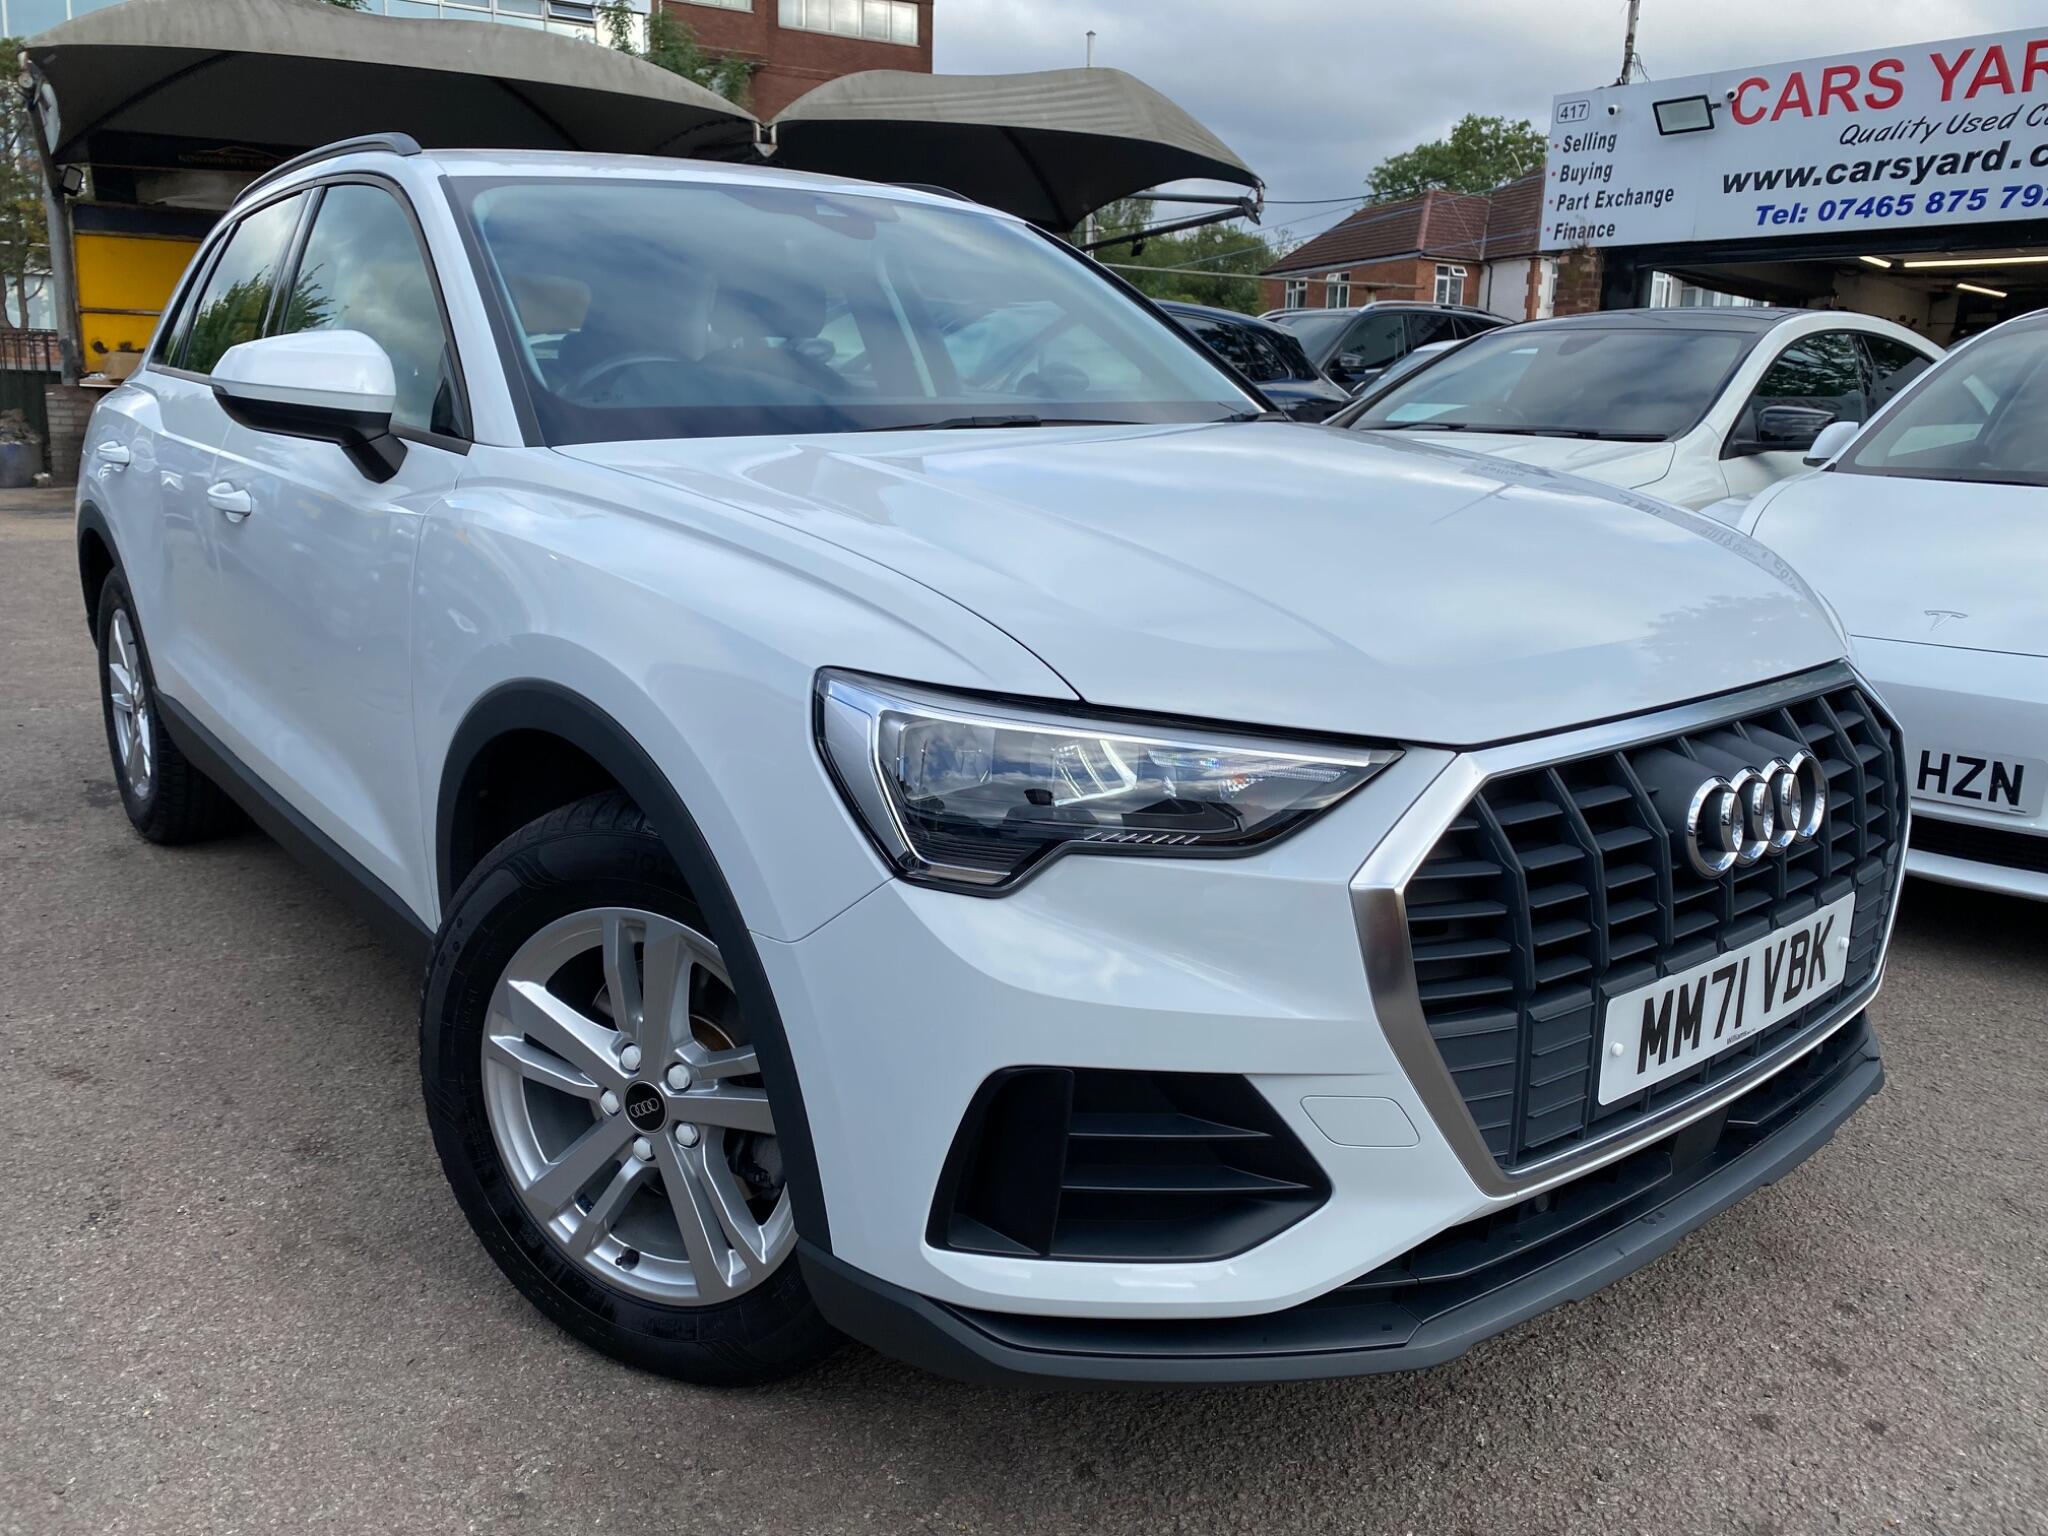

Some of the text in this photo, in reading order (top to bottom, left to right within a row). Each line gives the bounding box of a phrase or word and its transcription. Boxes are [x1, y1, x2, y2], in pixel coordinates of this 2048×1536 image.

[1731, 58, 1905, 125] CARS
[1559, 104, 1587, 120] 417
[1839, 116, 1941, 146] Quality
[1946, 104, 2024, 135] Used
[1562, 132, 1617, 153] Selling
[1559, 162, 1613, 186] Buying
[1556, 188, 1674, 212] Part Exchange
[1756, 202, 1808, 226] Tel:
[1818, 193, 1916, 222] 07465
[1925, 188, 1989, 214] 875
[1554, 222, 1615, 240] Finance
[1917, 750, 2024, 806] HZN
[1637, 914, 1835, 1075] MM71 VBK
